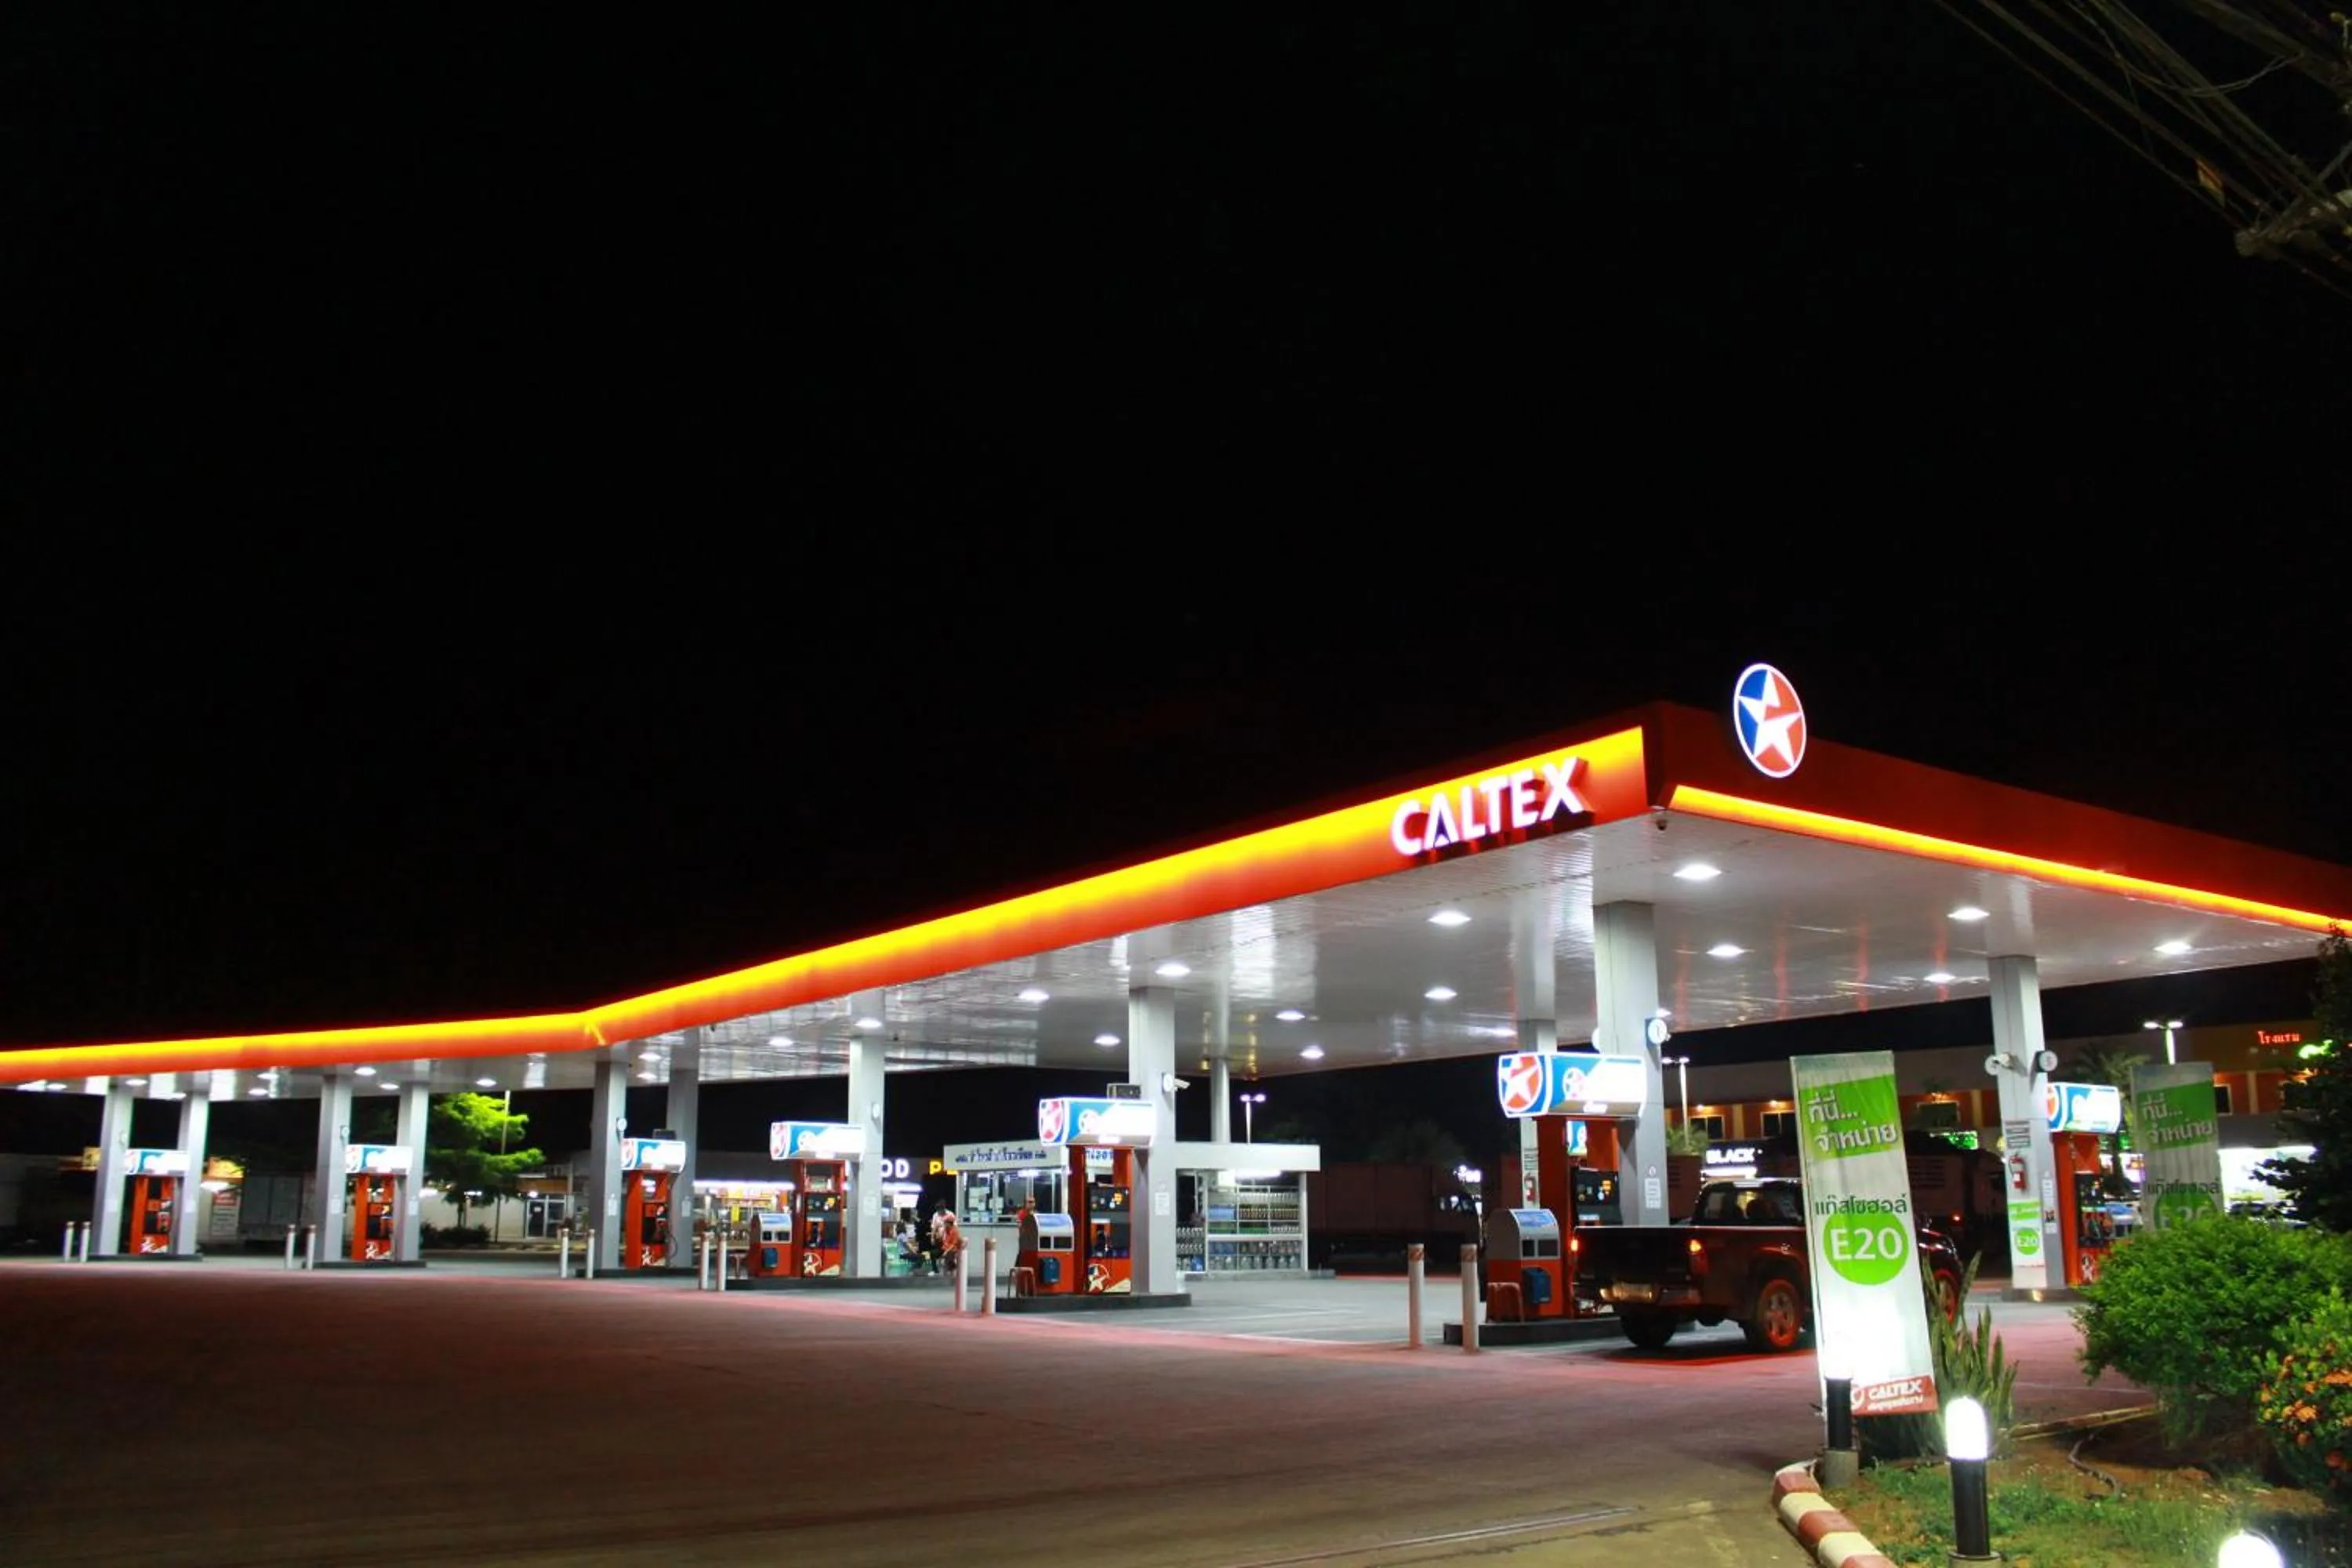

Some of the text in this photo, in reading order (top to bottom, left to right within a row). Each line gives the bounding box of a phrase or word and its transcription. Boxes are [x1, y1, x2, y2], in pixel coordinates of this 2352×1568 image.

[1391, 757, 1585, 856] CALTEX
[1807, 1089, 1858, 1123] ที่นี่...
[1814, 1120, 1896, 1152] จำหน่าย
[1814, 1192, 1908, 1216] แก๊สโซฮอล์
[1830, 1226, 1904, 1261] E20
[1868, 1379, 1923, 1401] CALTEX
